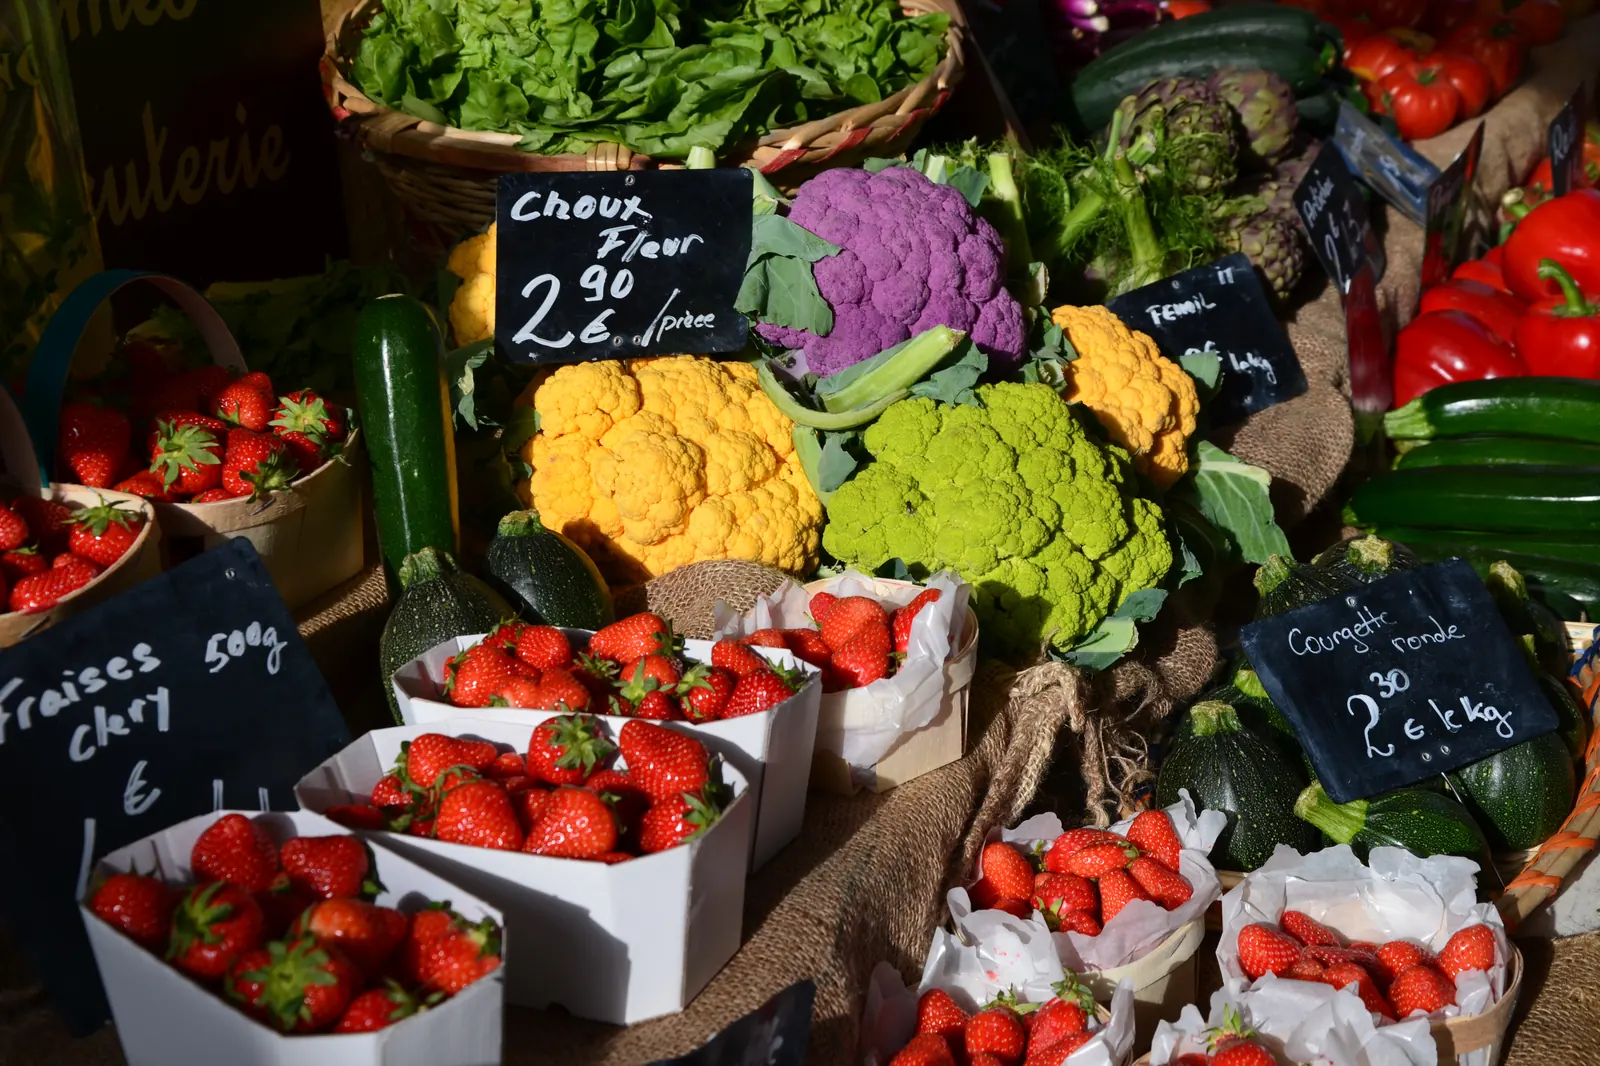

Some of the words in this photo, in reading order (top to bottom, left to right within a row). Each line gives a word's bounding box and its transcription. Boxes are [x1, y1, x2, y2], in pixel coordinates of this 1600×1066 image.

[511, 190, 653, 222] Choux
[596, 224, 704, 262] Fleur
[579, 265, 634, 301] 90
[511, 273, 575, 348] 2
[579, 308, 616, 344] €
[205, 621, 288, 675] 500g
[1288, 605, 1398, 656] Courgette
[1391, 615, 1466, 653] ronde
[1369, 668, 1410, 699] 30
[1347, 693, 1395, 759] 2
[1459, 695, 1514, 738] kg
